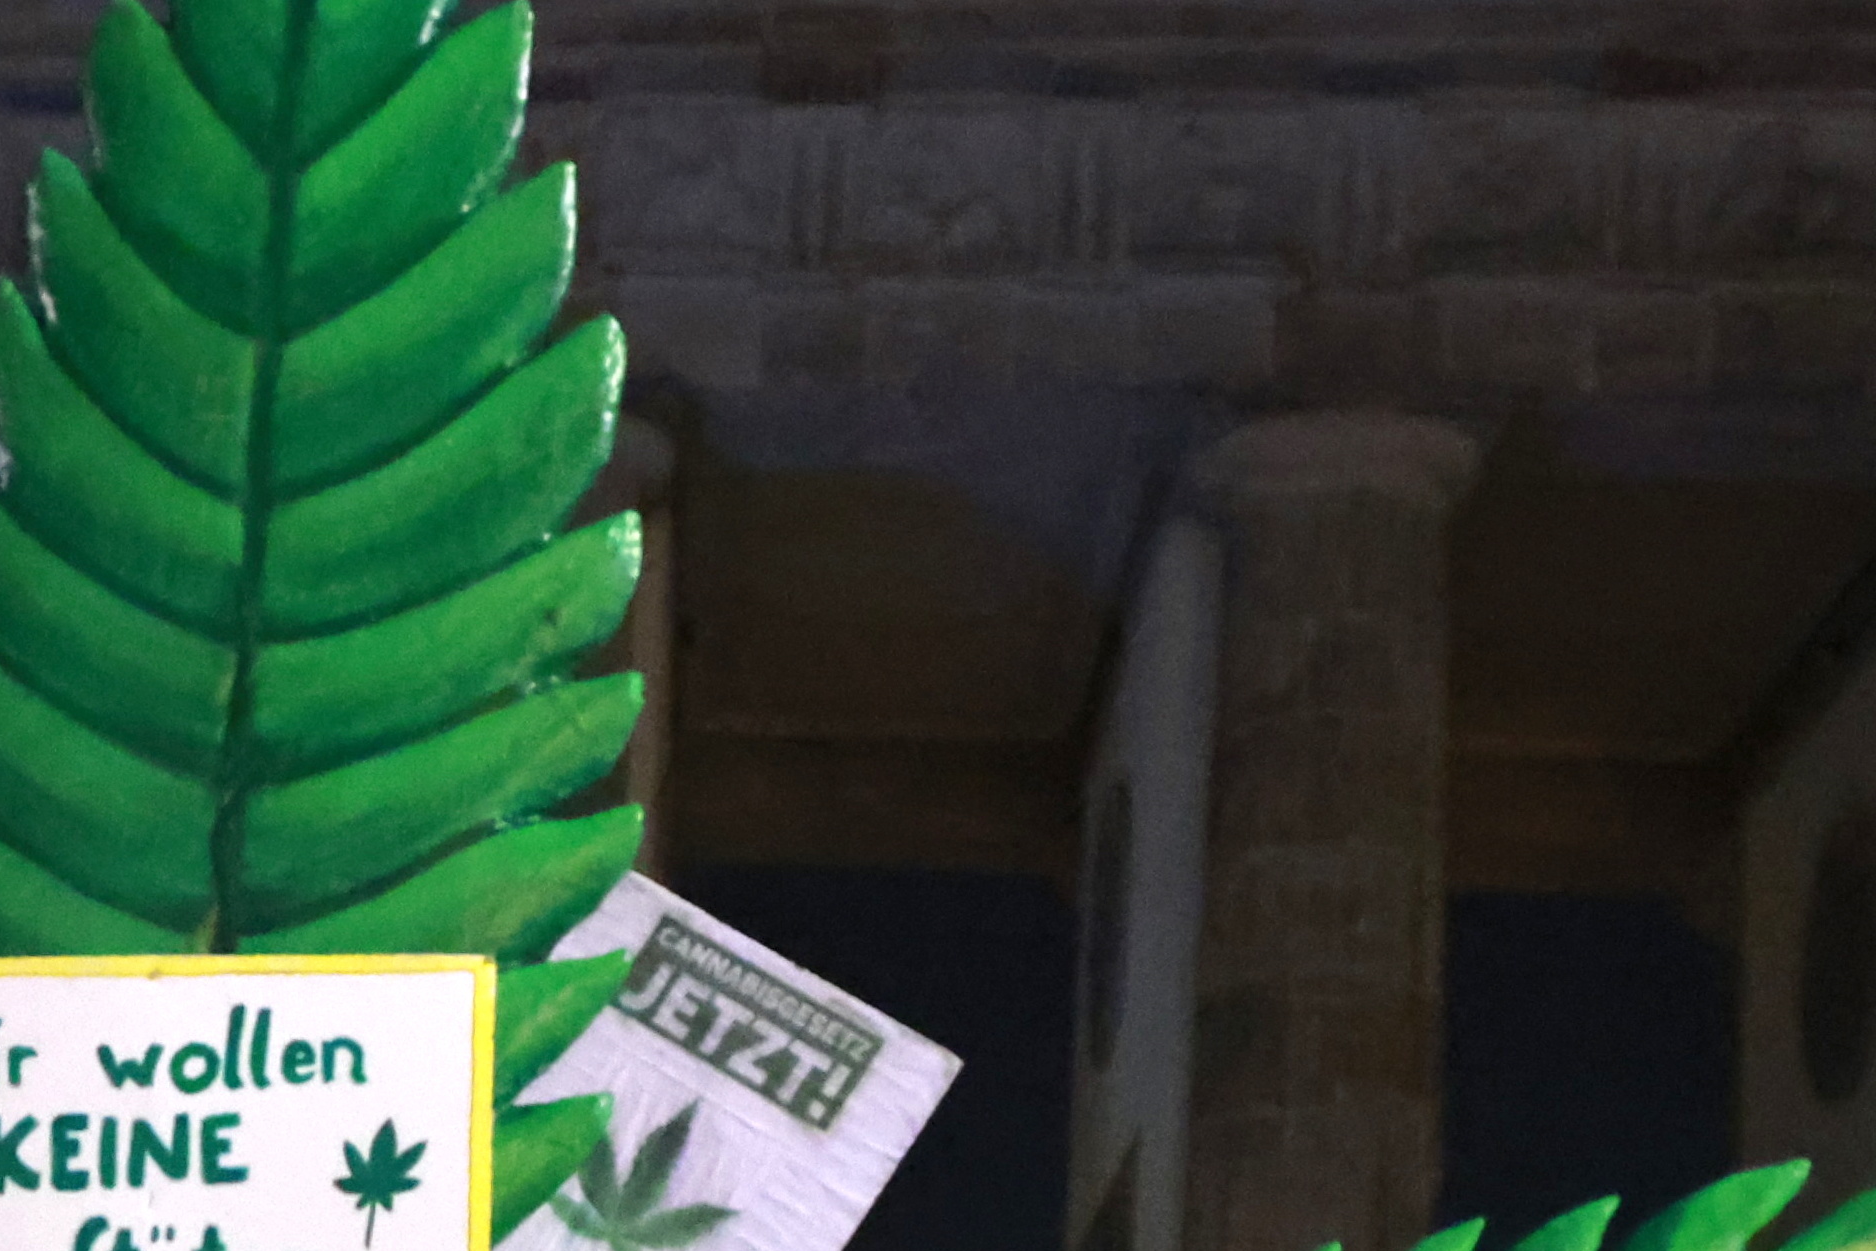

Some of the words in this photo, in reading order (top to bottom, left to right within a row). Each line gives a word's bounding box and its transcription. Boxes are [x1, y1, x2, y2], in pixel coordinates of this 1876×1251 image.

[96, 1003, 368, 1095] wollen
[618, 962, 853, 1120] JETZT!
[656, 925, 875, 1063] CANNABISGESETZ
